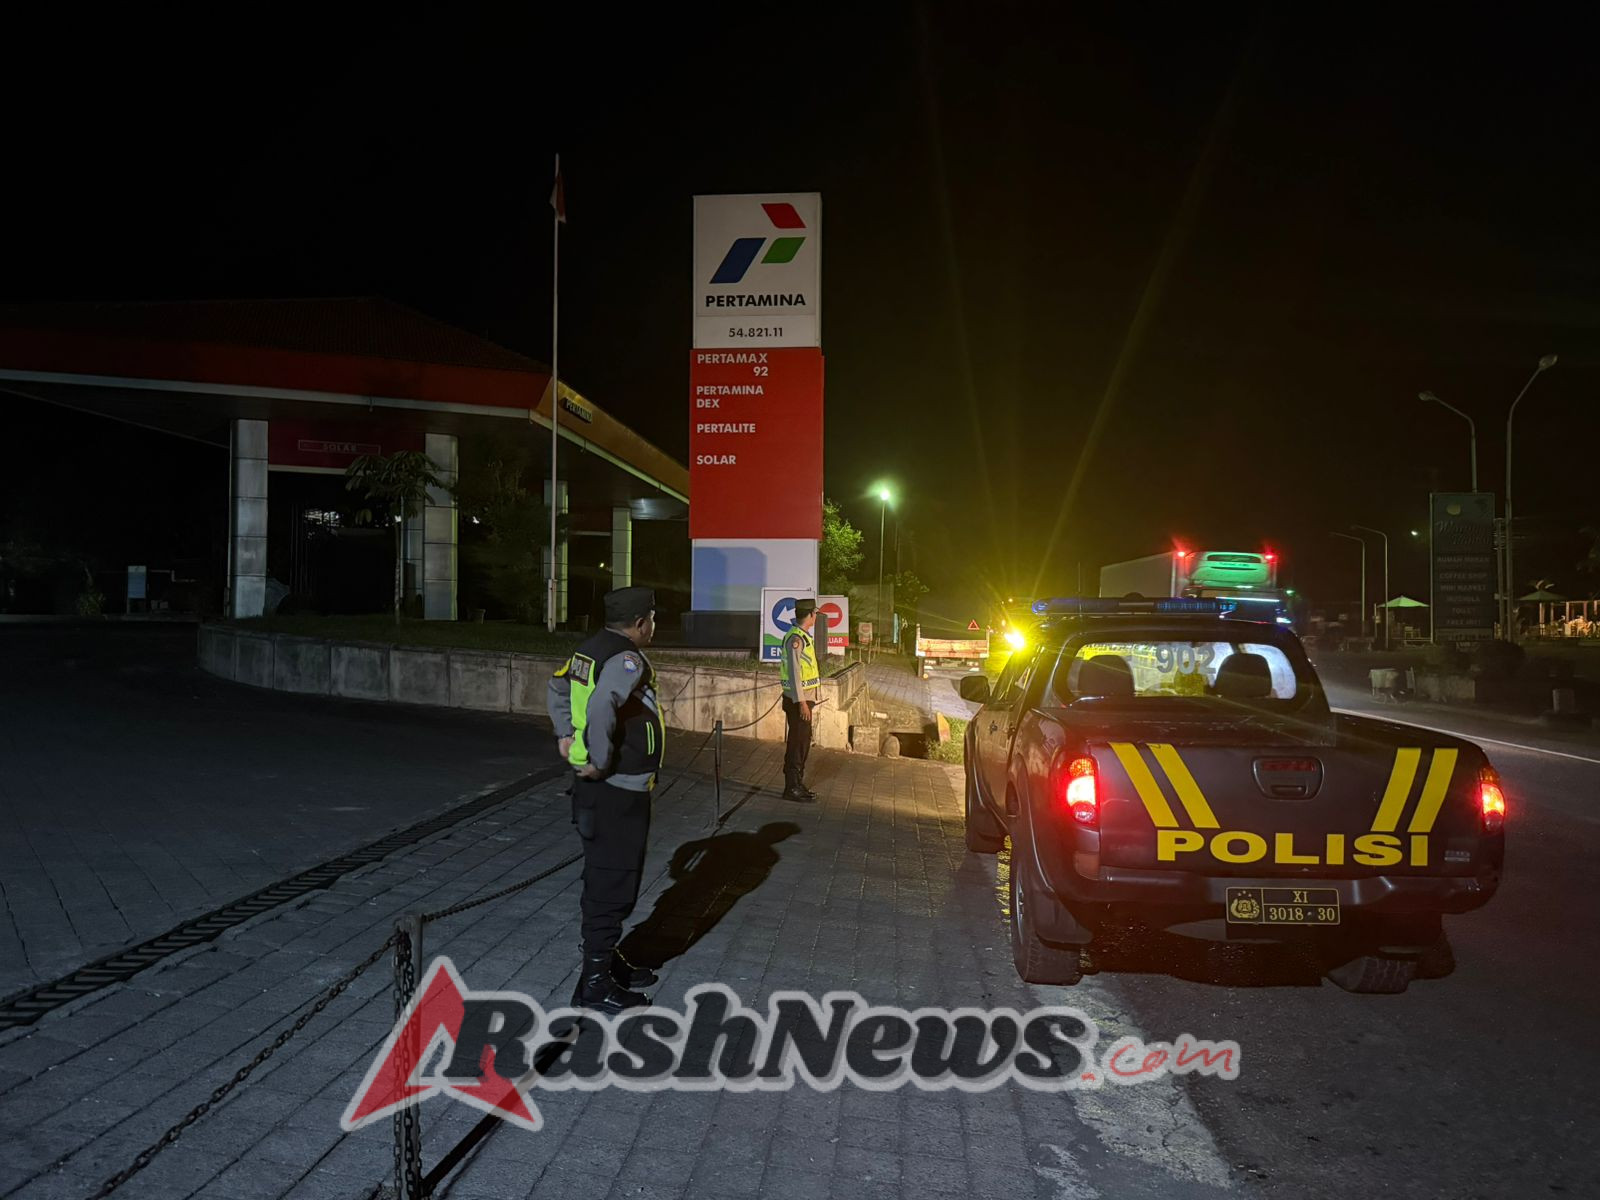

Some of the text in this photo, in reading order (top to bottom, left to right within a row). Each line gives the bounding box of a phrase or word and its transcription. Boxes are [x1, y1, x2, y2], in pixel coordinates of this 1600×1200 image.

[705, 294, 806, 307] PERTAMINA
[728, 327, 783, 338] 54.821.11
[697, 353, 768, 364] PERTAMAX
[753, 366, 769, 377] 92
[696, 385, 764, 396] PERTAMINA
[696, 398, 720, 409] DEX
[696, 423, 756, 434] PERTALITE
[696, 455, 737, 466] SOLAR
[1156, 645, 1216, 674] 902
[1157, 830, 1428, 866] POLISI
[1293, 891, 1308, 903] XI
[1269, 907, 1335, 921] 3018 30
